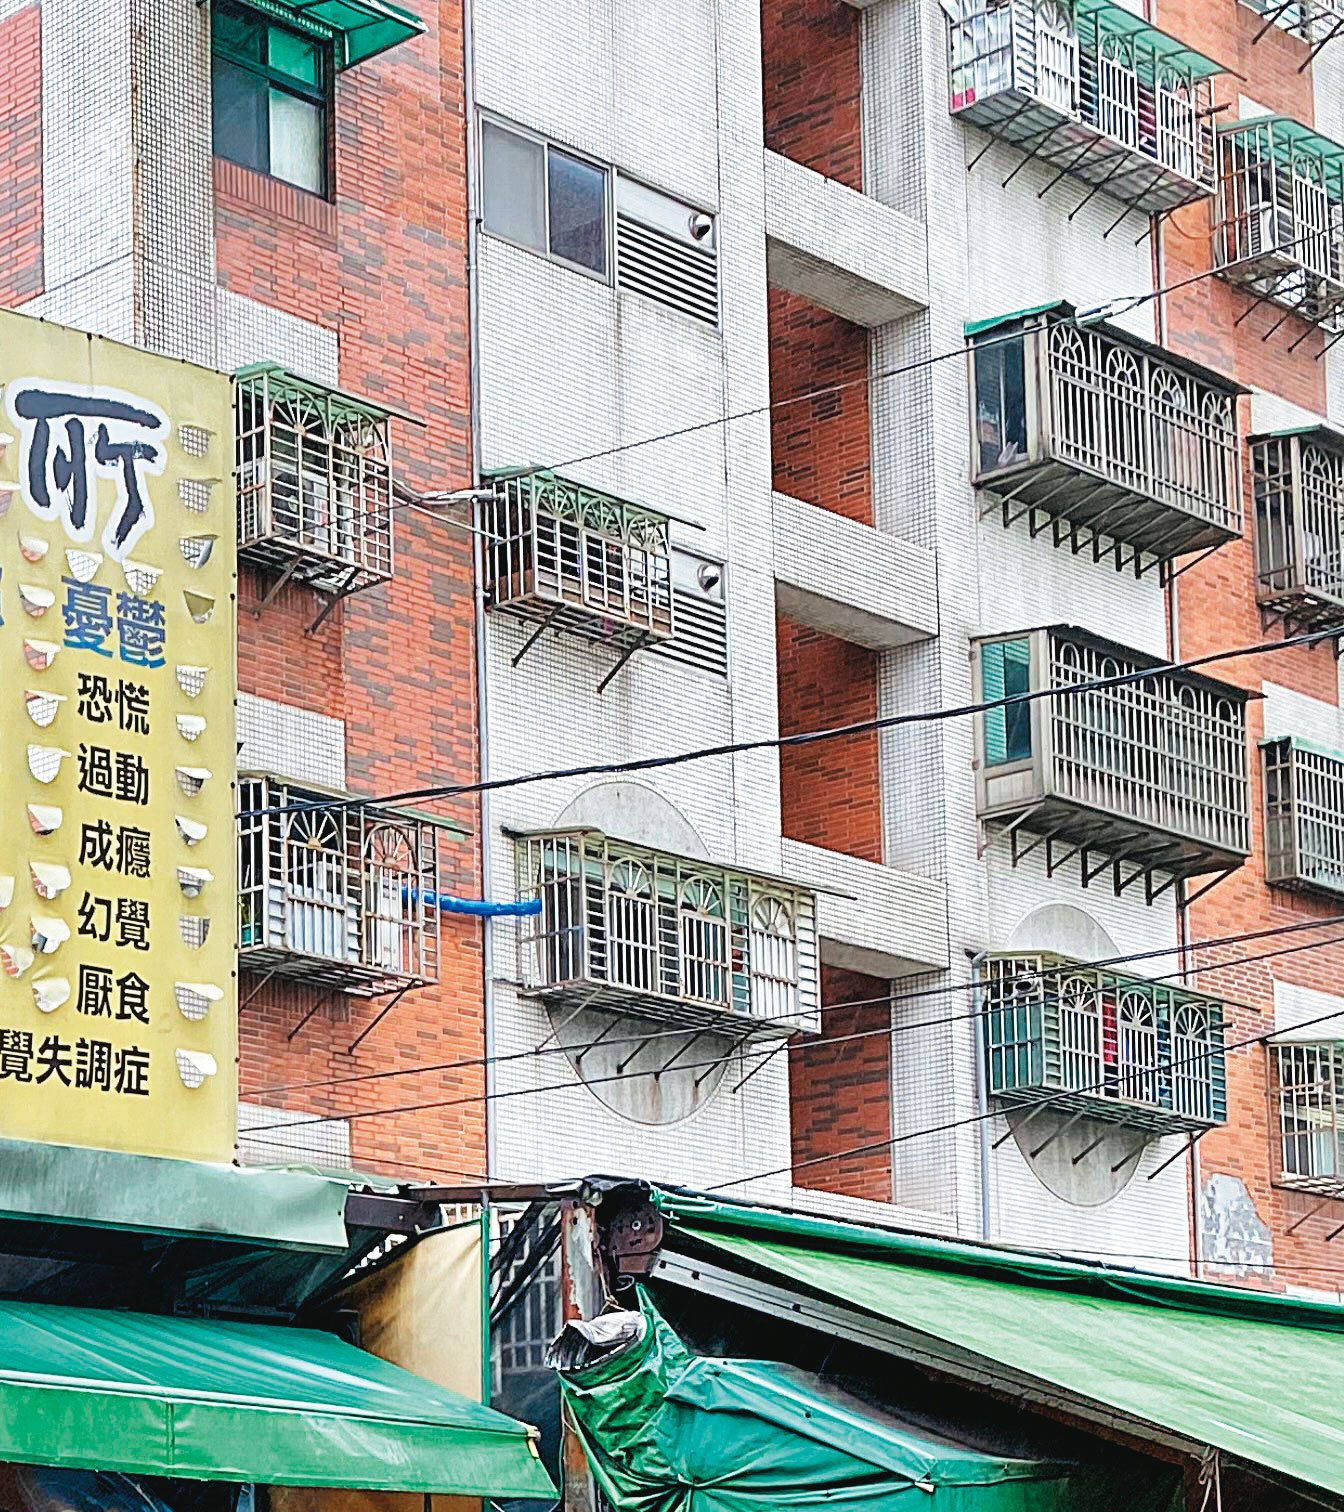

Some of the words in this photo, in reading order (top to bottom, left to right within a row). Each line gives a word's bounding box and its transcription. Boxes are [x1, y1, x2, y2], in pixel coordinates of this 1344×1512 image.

[61, 576, 167, 669] 憂鬱
[77, 672, 149, 735] 恐慌
[77, 742, 149, 806] 過動
[79, 820, 150, 878] 成癮
[79, 891, 150, 952] 幻覺
[76, 964, 150, 1025] 厭食
